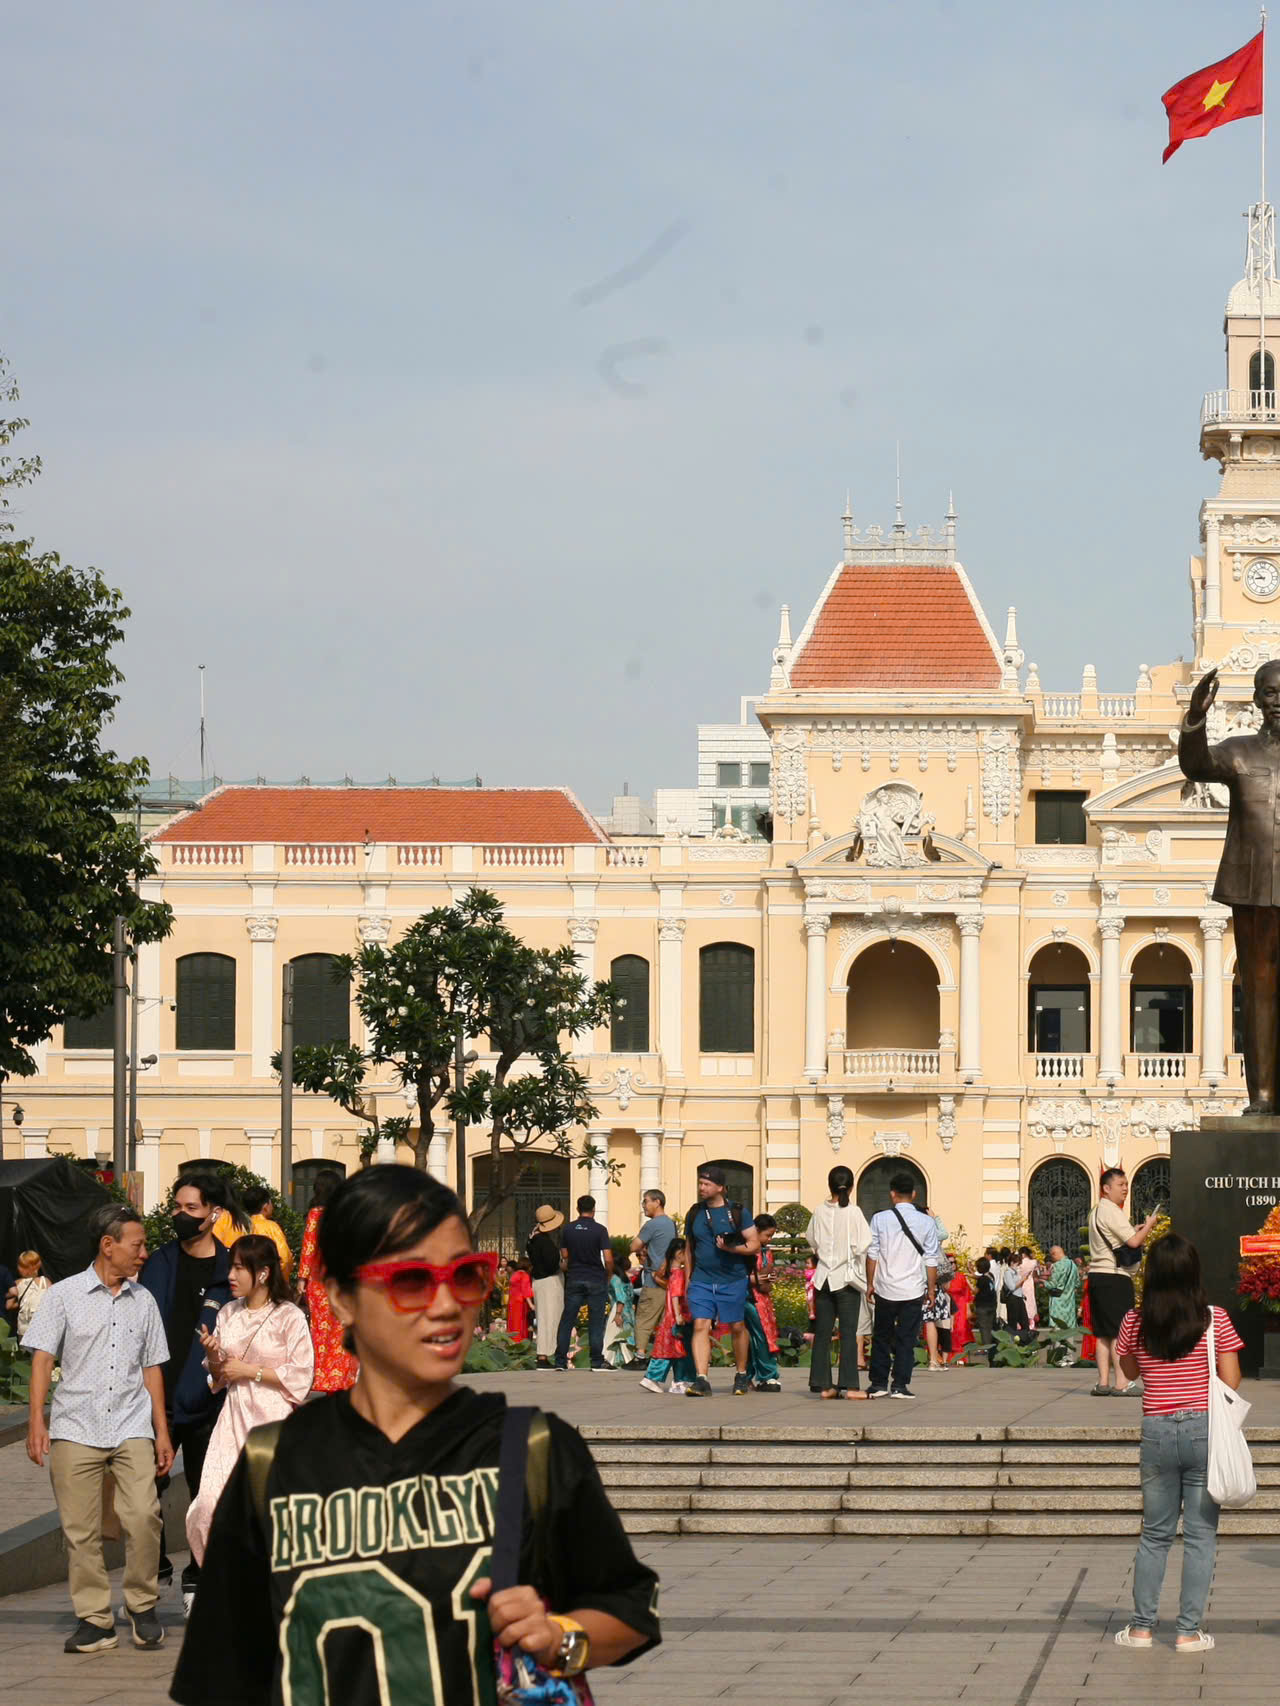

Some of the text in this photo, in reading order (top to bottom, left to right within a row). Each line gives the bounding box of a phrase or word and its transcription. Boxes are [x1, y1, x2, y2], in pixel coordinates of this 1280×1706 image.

[1205, 1174, 1234, 1188] CHỦ
[1236, 1176, 1269, 1191] TỊCH
[1245, 1195, 1277, 1207] (1890
